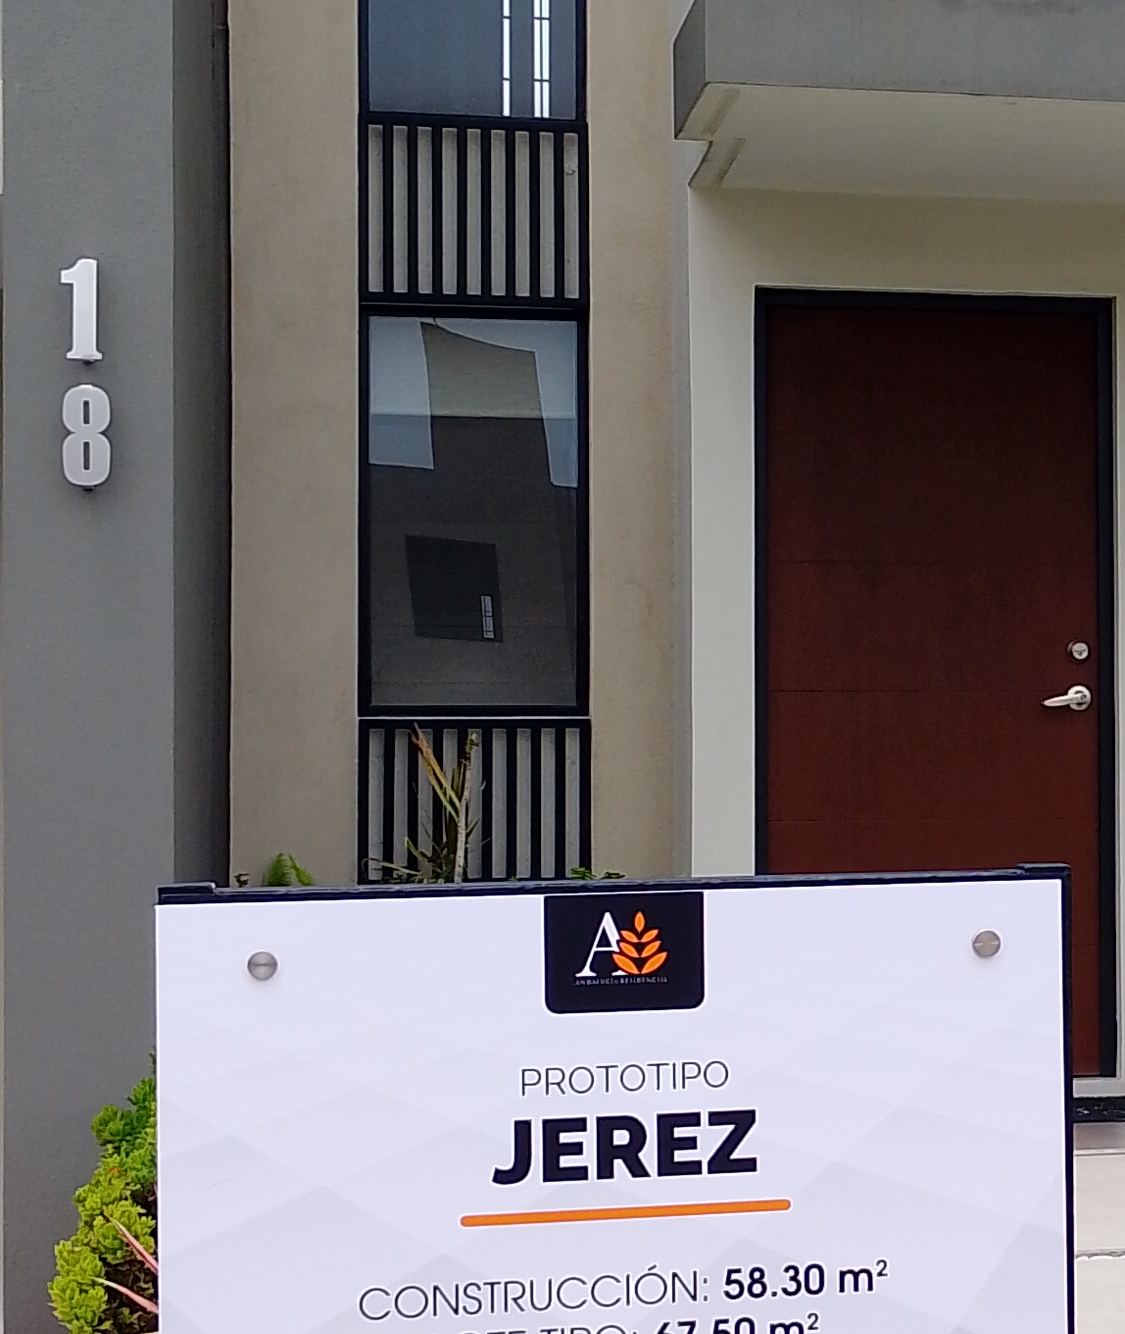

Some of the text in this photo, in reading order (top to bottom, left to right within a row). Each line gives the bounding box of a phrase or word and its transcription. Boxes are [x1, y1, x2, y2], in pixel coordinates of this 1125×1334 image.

[521, 1060, 729, 1097] PROTOTIPO
[491, 1108, 758, 1186] JEREZ
[358, 1264, 708, 1321] CONSTRUCCIÓN:
[722, 1263, 825, 1301] 58.30
